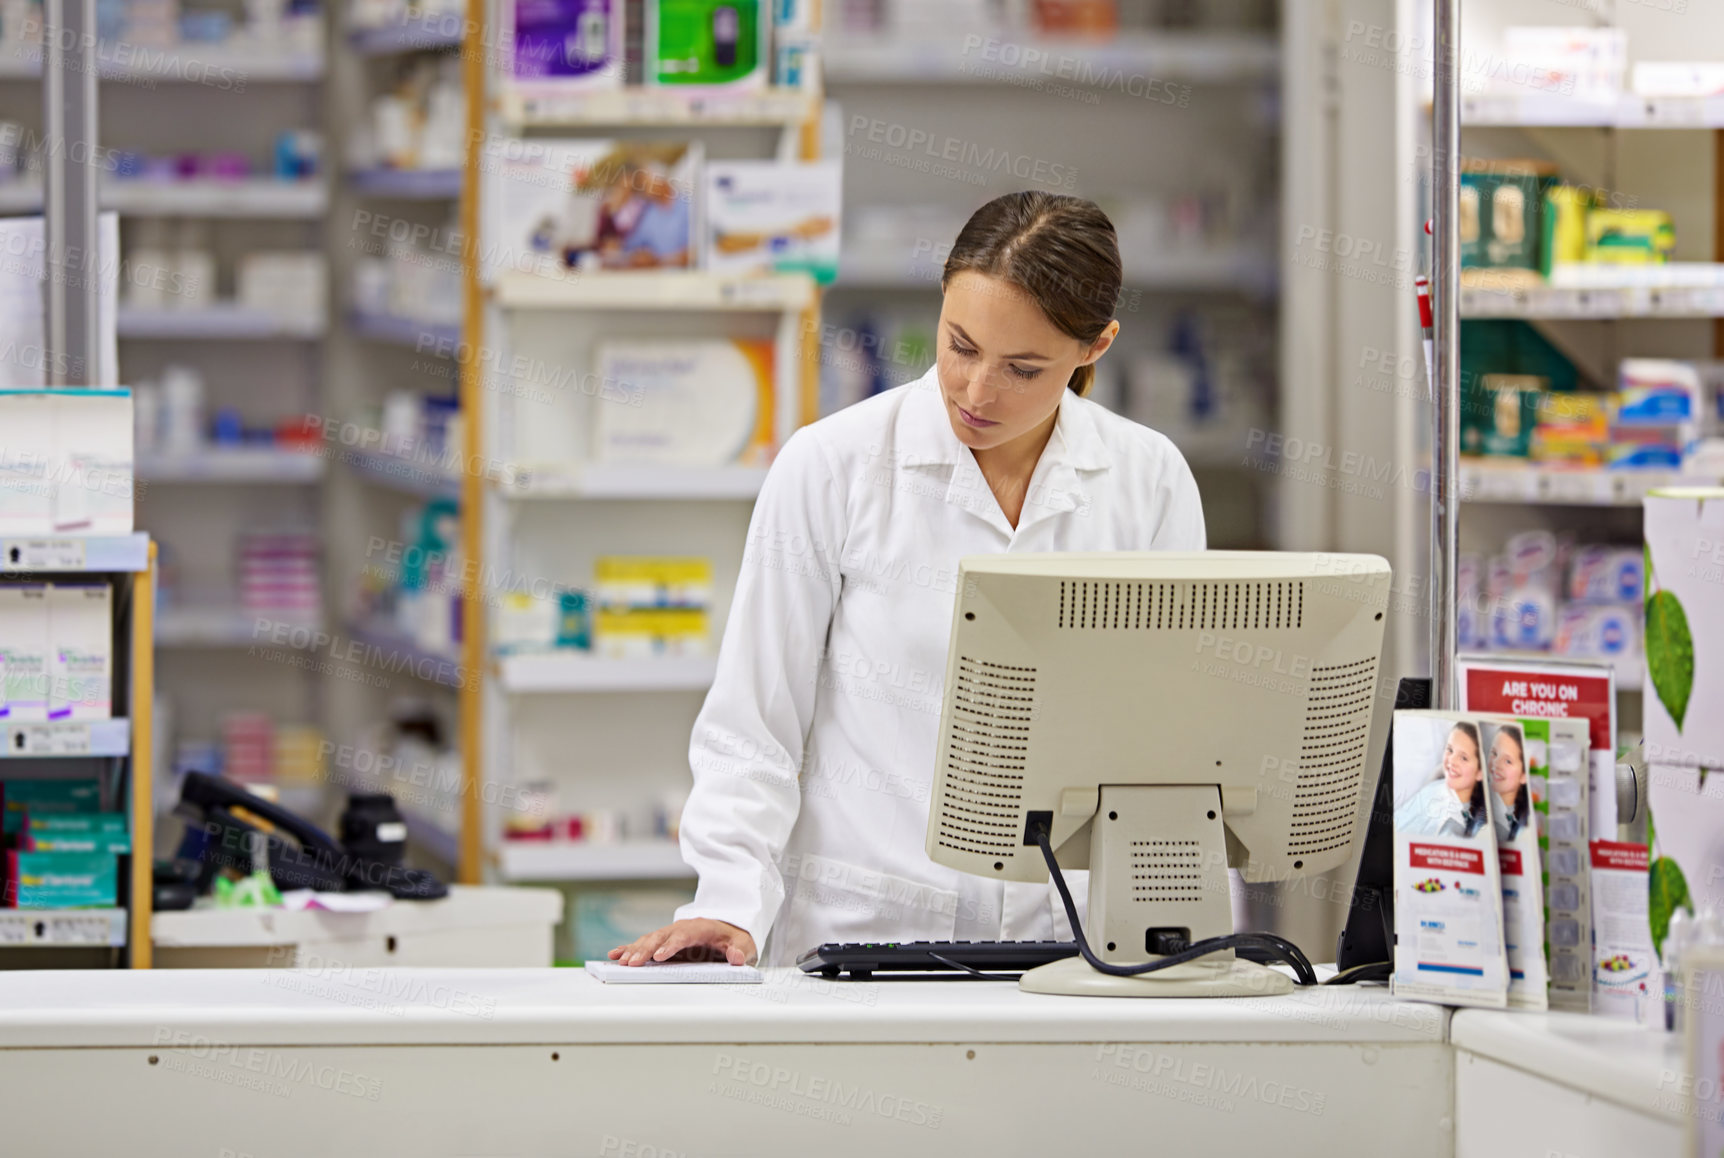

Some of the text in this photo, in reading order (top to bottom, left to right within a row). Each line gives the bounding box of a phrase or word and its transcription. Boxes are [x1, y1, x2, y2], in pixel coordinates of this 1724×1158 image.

[1502, 680, 1578, 701] ARE YOU ON
[1512, 699, 1569, 717] CHRONIC
